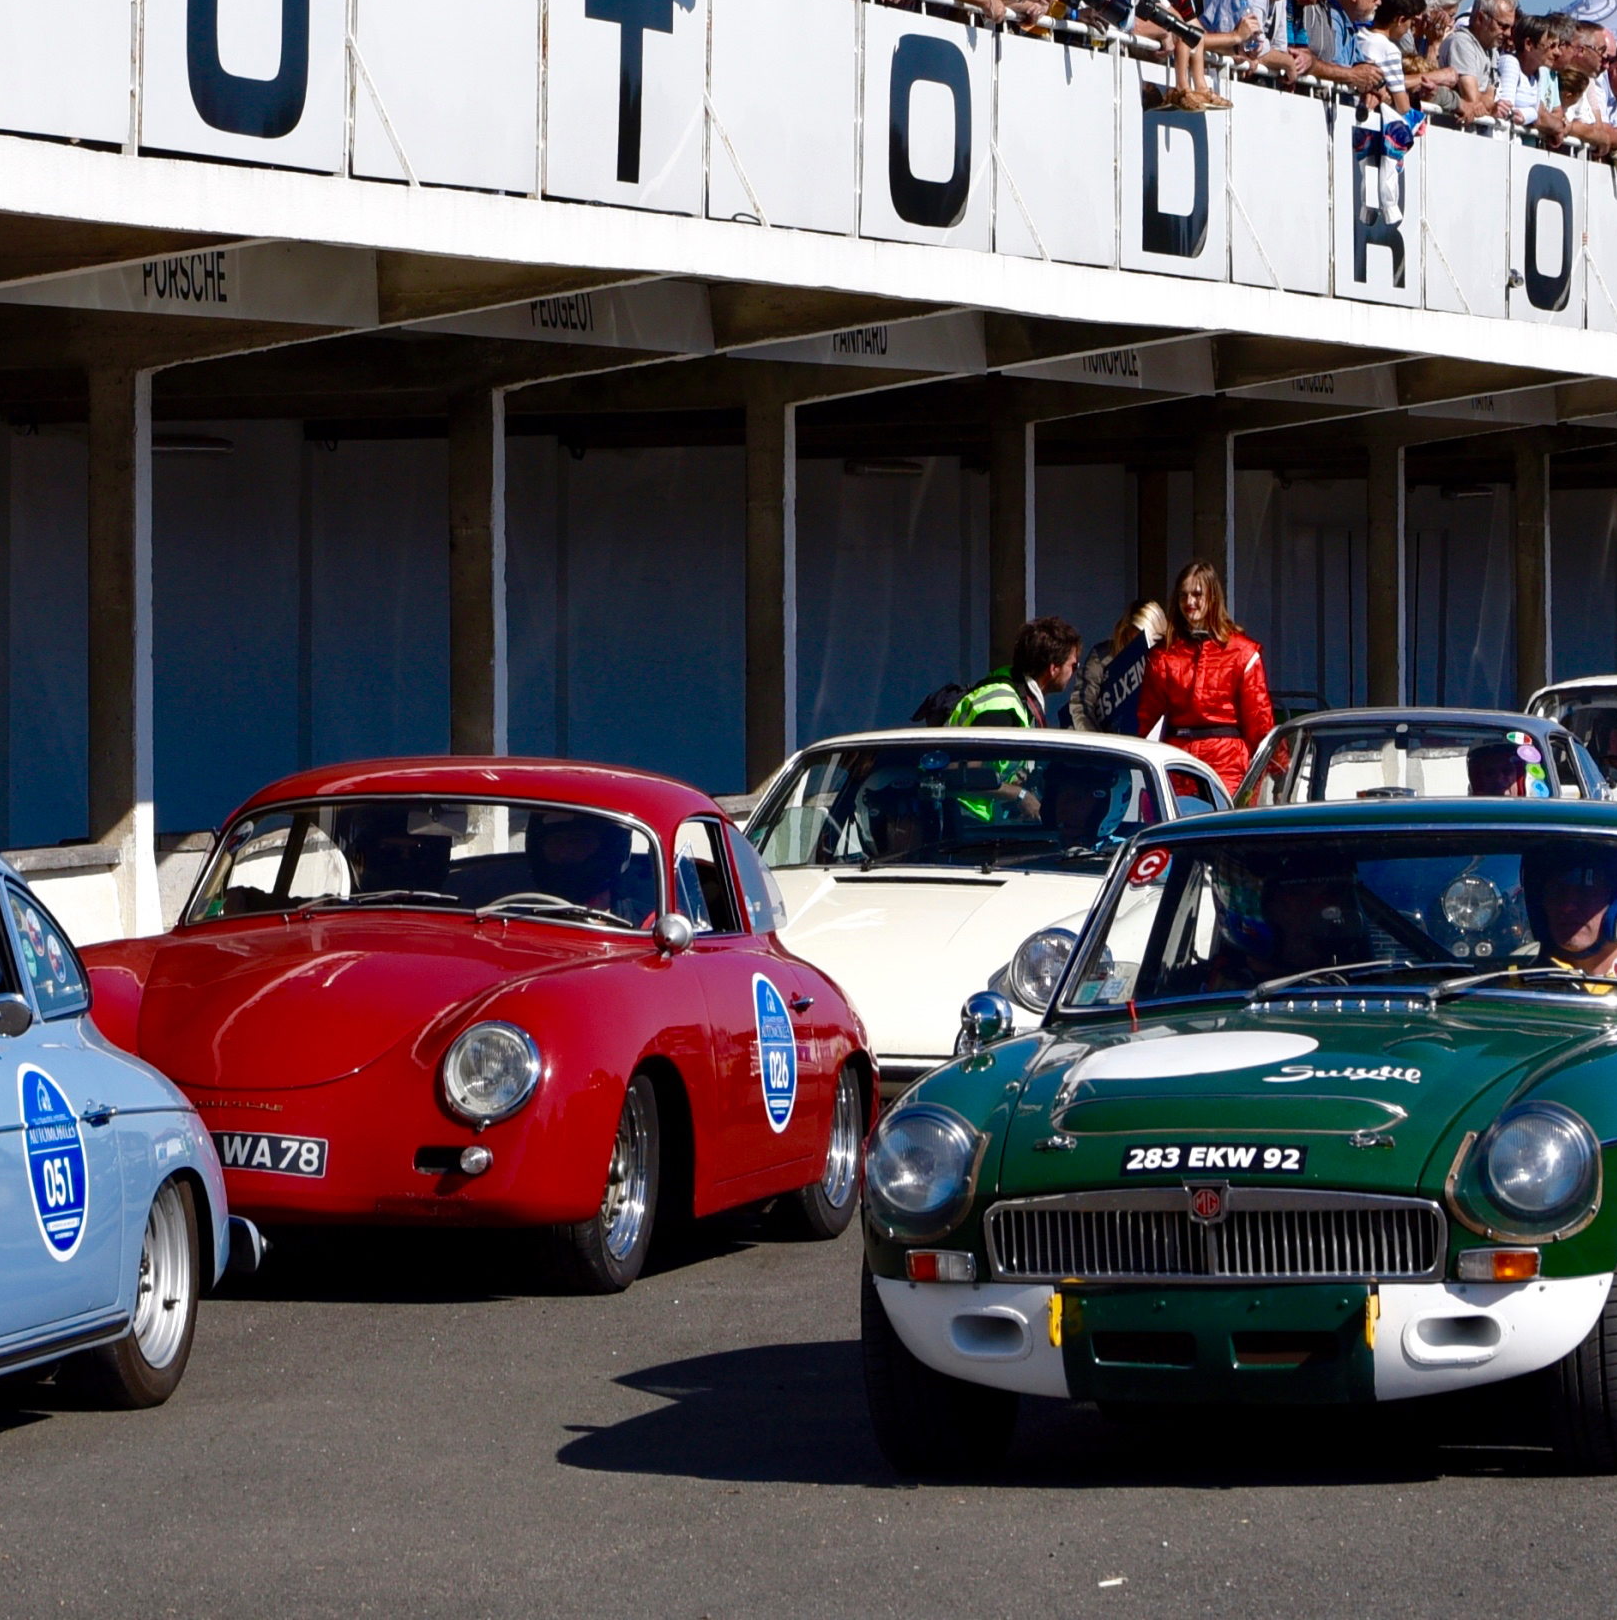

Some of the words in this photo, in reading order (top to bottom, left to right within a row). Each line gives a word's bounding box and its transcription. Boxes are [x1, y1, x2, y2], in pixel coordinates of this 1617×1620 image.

[143, 251, 228, 303] PORSCHE
[531, 292, 594, 332] PEUGEOT
[769, 1051, 790, 1090] 026
[1126, 1146, 1180, 1170] 283
[1188, 1146, 1257, 1169] EKW
[1263, 1148, 1301, 1170] 92
[43, 1156, 75, 1208] 051
[1196, 1192, 1219, 1211] MG
